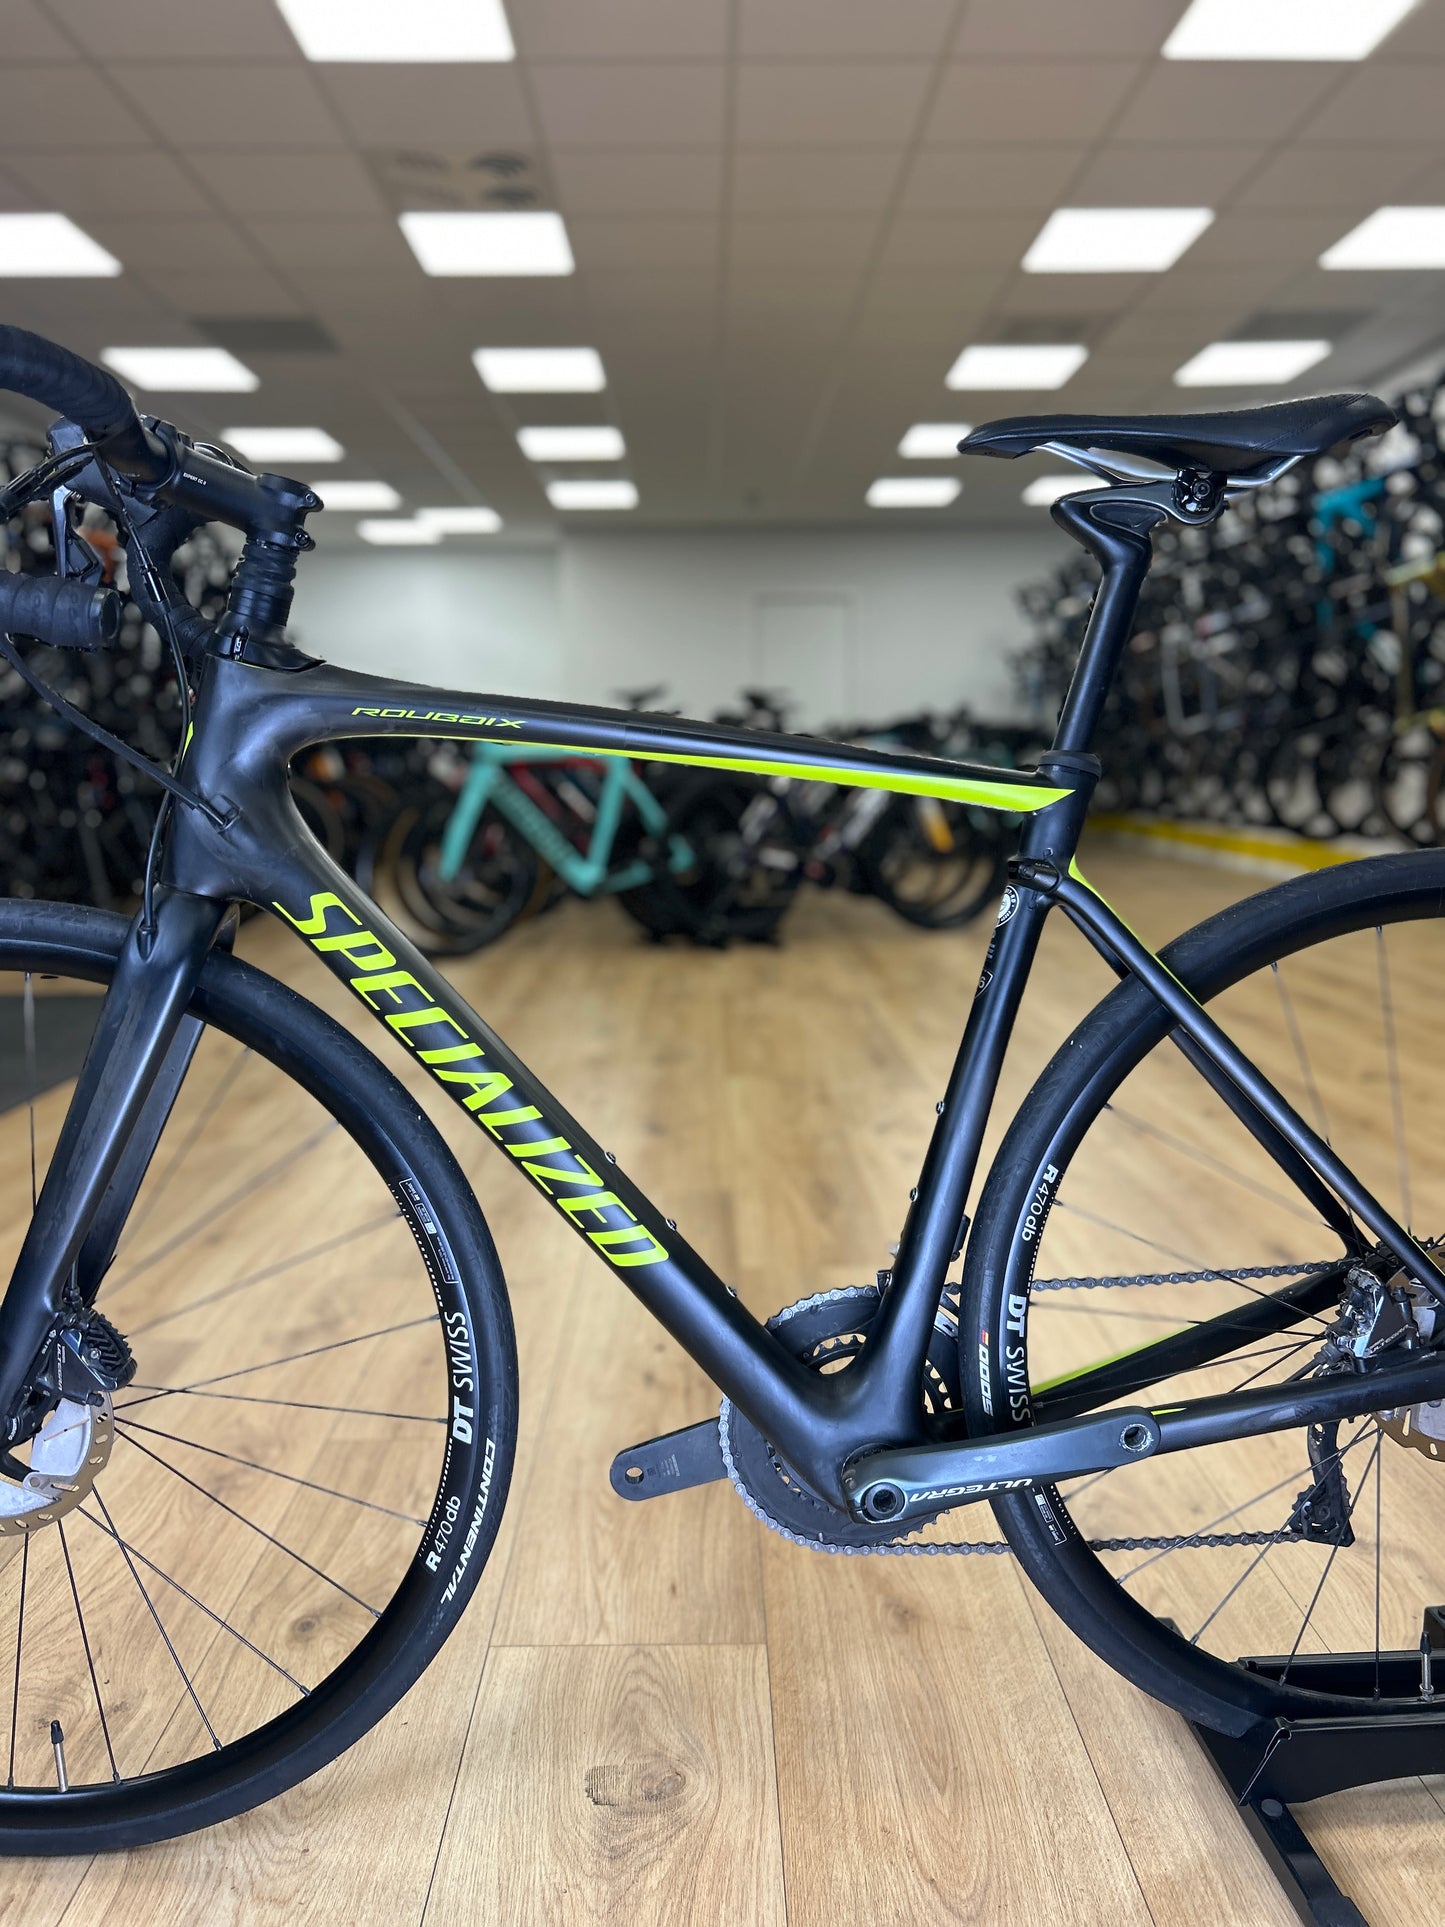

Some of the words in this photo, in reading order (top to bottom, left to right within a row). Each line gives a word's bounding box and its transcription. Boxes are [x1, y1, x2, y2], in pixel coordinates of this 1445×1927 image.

[272, 891, 668, 1268] SPECIALIZED
[444, 1311, 474, 1392] SWISS
[1006, 1293, 1027, 1338] DT
[452, 1395, 474, 1445] DT
[1005, 1346, 1031, 1422] SWISS
[440, 1437, 496, 1604] CONTINENTAL
[909, 1478, 1033, 1503] ULTEGRA
